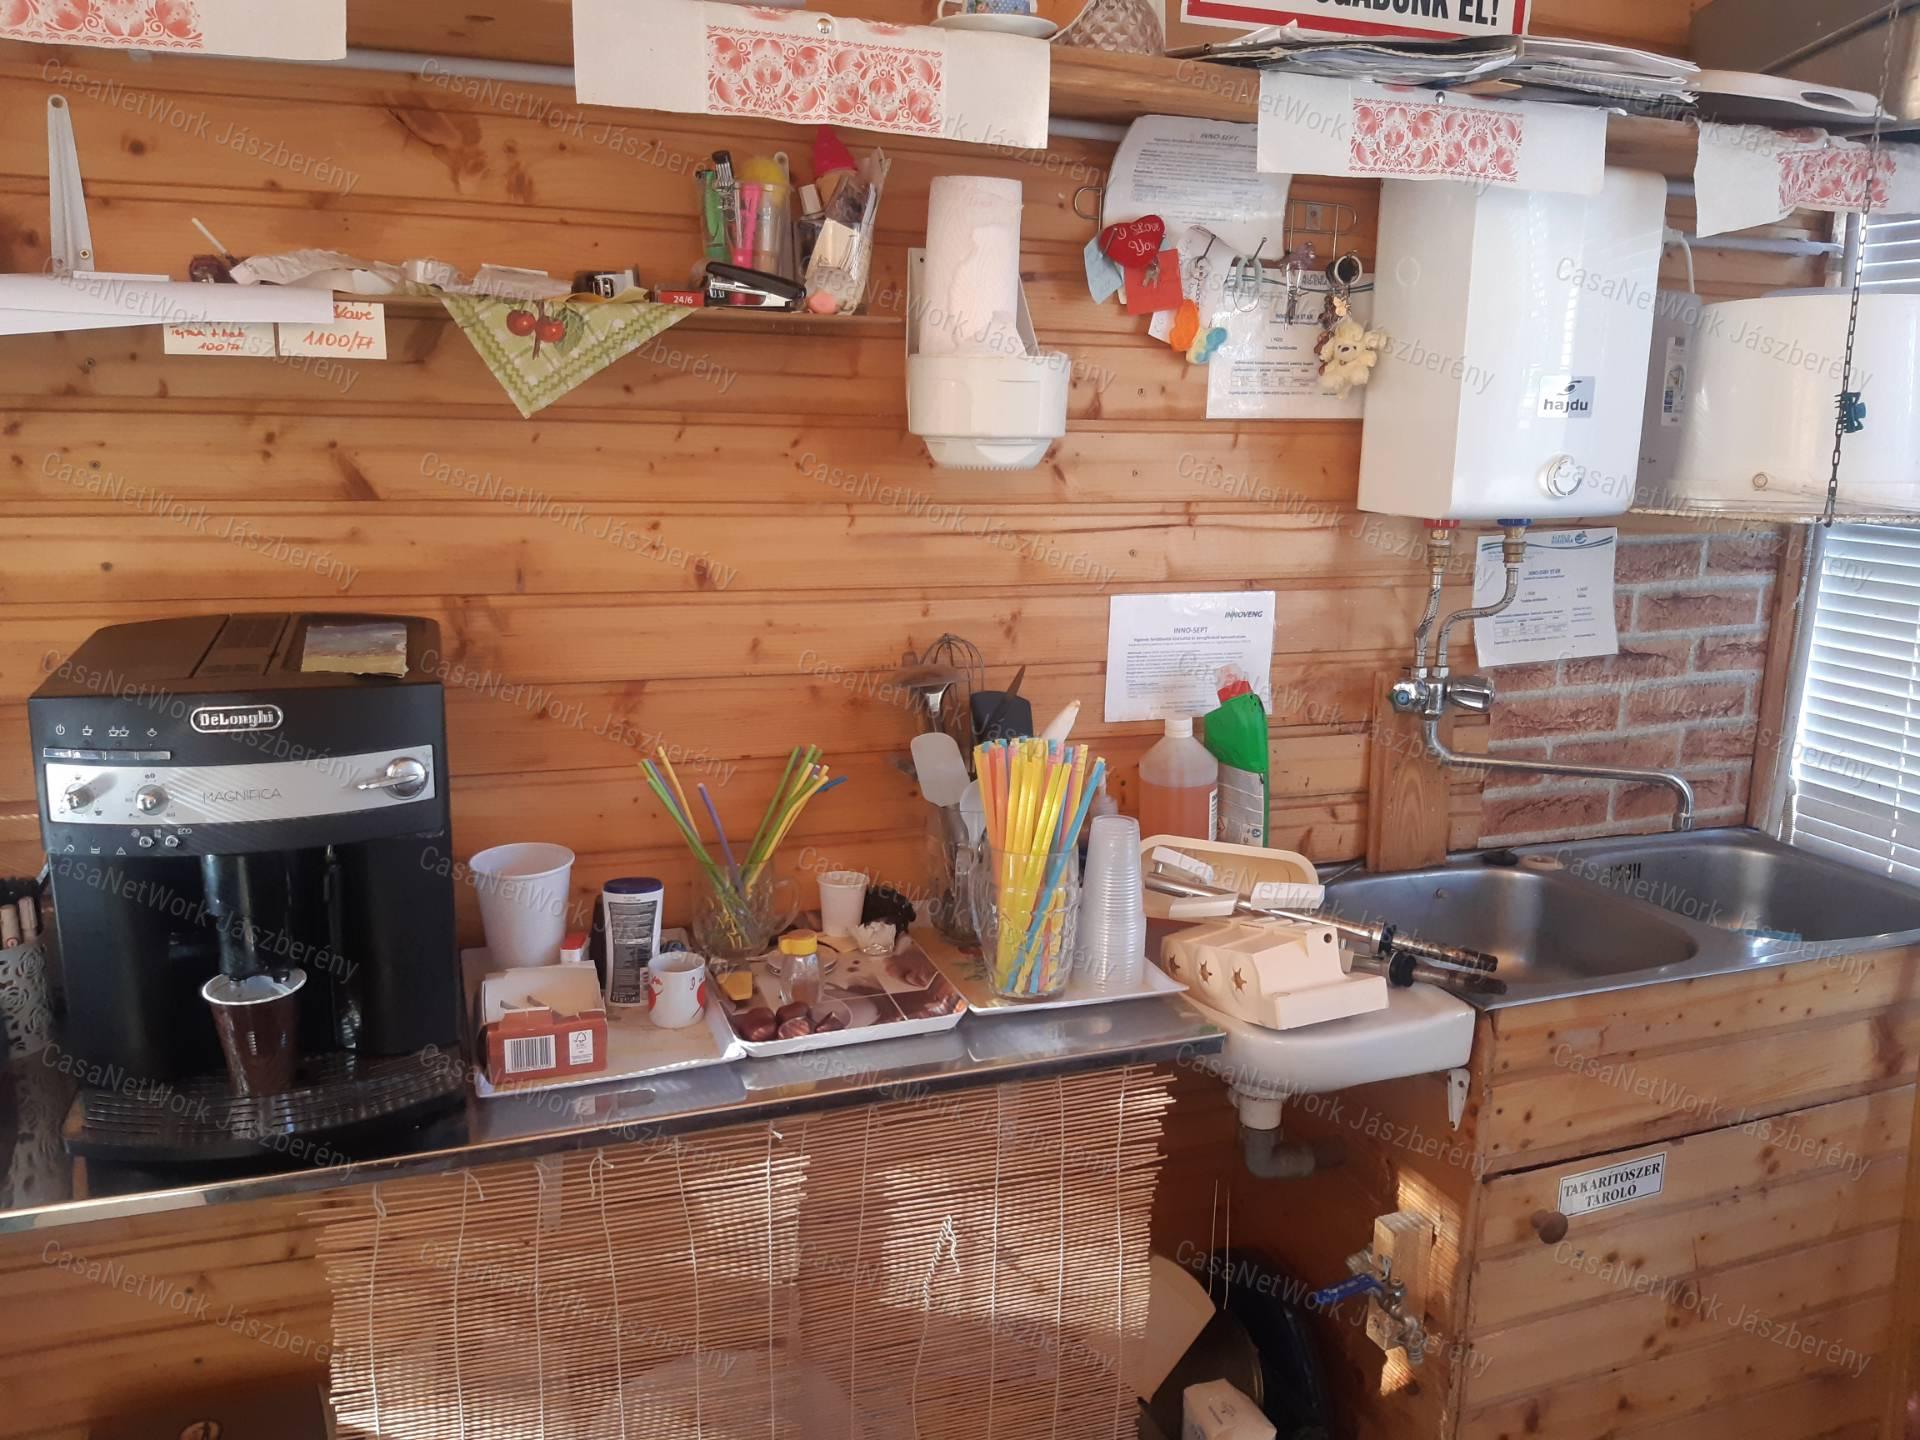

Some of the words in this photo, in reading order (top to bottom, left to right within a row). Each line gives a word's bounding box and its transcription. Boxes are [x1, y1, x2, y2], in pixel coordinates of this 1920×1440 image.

[673, 295, 694, 305] 24/6
[1543, 398, 1589, 413] hajdu
[1173, 626, 1208, 634] INNO-SEPT
[203, 788, 282, 804] MAGNIFICA
